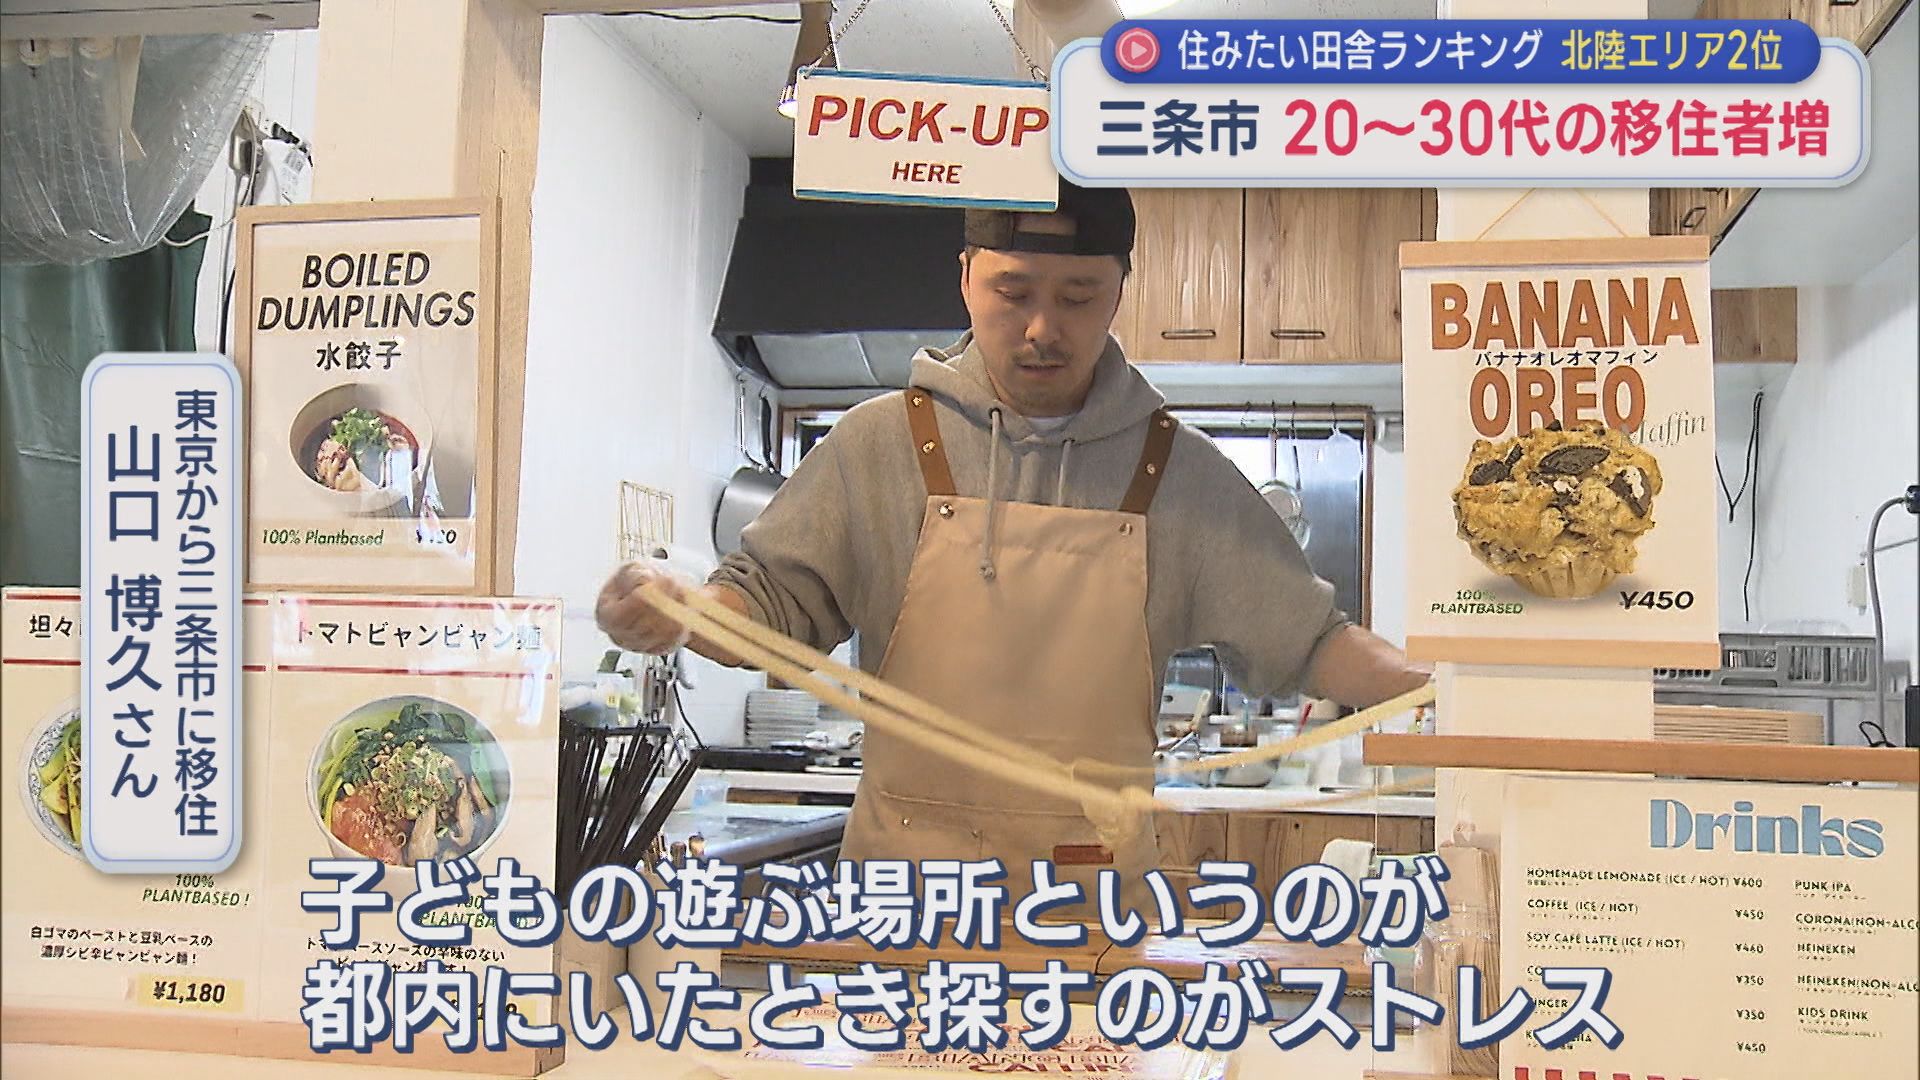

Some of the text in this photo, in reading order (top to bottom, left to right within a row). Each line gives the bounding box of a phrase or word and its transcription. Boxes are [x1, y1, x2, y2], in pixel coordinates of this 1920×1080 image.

[807, 95, 1050, 147] PICK-UP
[891, 161, 963, 185] HERE
[302, 251, 431, 290] BOILED
[257, 290, 477, 331] DUMPLINGS
[1431, 276, 1701, 350] BANANA
[315, 341, 402, 371] 水餃子
[1474, 349, 1659, 367] バナナオレオマフィン
[1469, 364, 1647, 439] OREO
[262, 528, 385, 545] 100% Plantbased
[1431, 601, 1524, 615] PLANTBASED
[1619, 590, 1695, 610] ¥450
[29, 615, 82, 638] 坦々
[1650, 798, 1884, 859] Drinks
[176, 873, 215, 888] 100%
[1527, 868, 1594, 880] HOMEMADE
[1597, 871, 1662, 884] LEMONADE
[1795, 880, 1852, 893] PUNK IPA
[1527, 899, 1569, 910] COFFEE
[1609, 903, 1639, 916] HOT)
[1735, 909, 1765, 921] ¥450
[1526, 932, 1551, 943] SOY
[1585, 935, 1619, 947] LATTE
[1656, 939, 1686, 951] HOT)
[1797, 943, 1857, 955] HEINEKEN
[1736, 975, 1765, 987] ¥350
[152, 980, 226, 1004] ¥1,180
[1736, 1009, 1766, 1021] ¥350
[1797, 1007, 1868, 1021] KIDS DRINK
